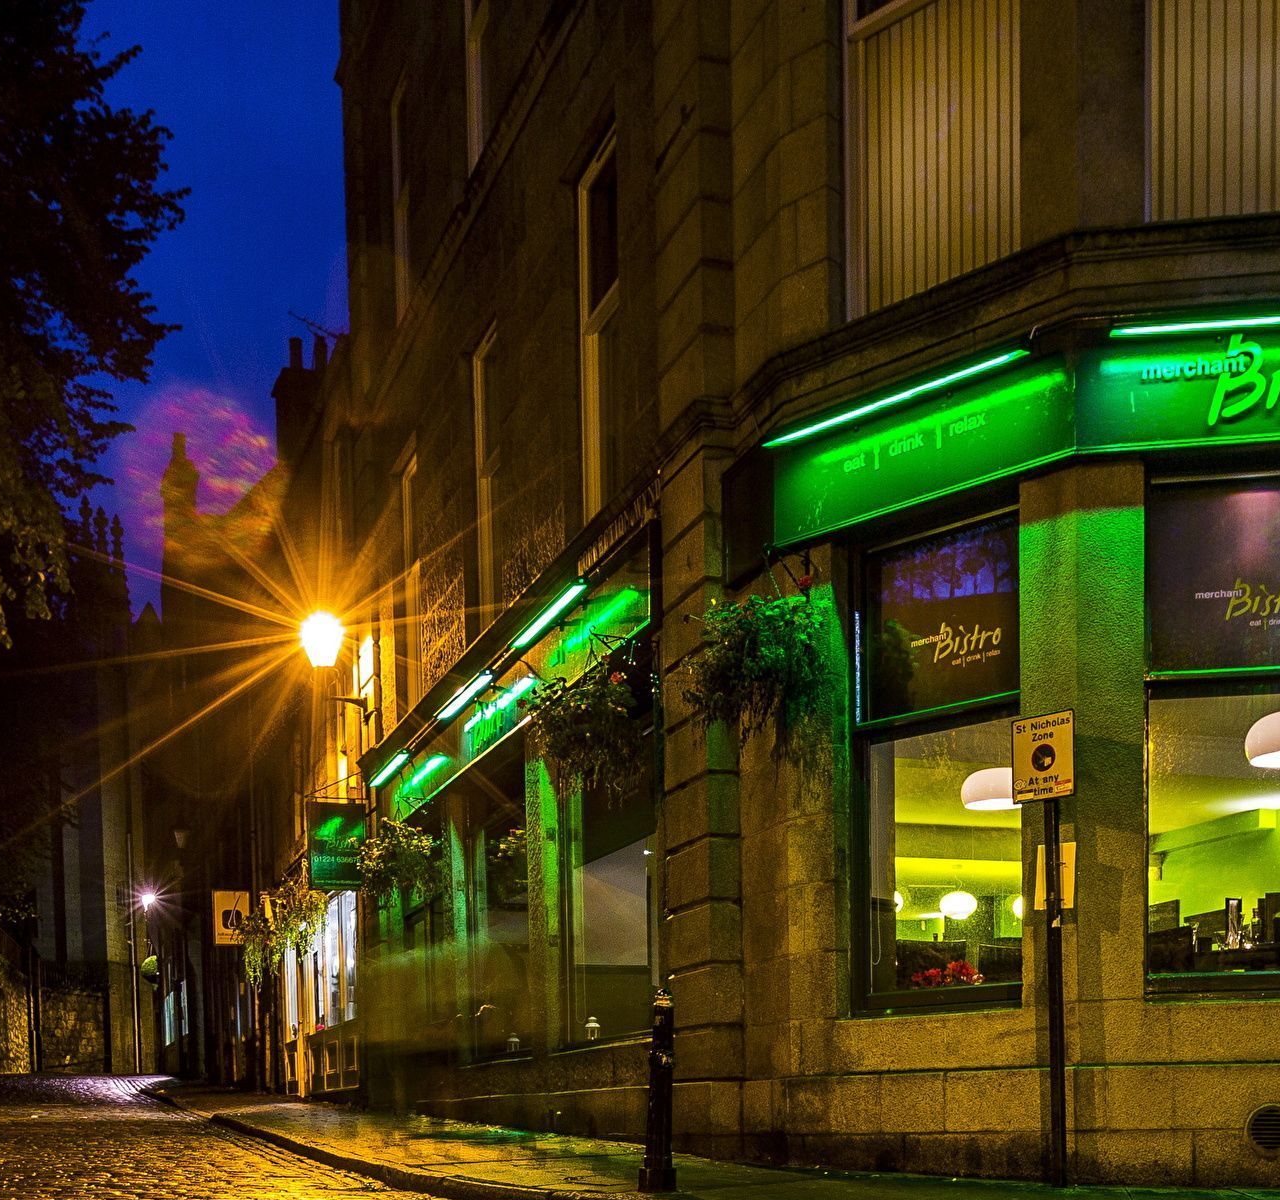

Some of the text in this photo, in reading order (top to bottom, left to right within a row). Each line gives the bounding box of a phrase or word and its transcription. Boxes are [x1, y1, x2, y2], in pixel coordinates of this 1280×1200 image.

[1141, 354, 1247, 380] merchant
[843, 412, 986, 473] eat drink relax
[1194, 589, 1242, 600] merchant
[910, 622, 1002, 664] merchant Bistro
[1016, 716, 1071, 734] St Nicholas
[1031, 731, 1054, 742] Zone
[1028, 774, 1060, 786] At any
[1033, 786, 1054, 797] time
